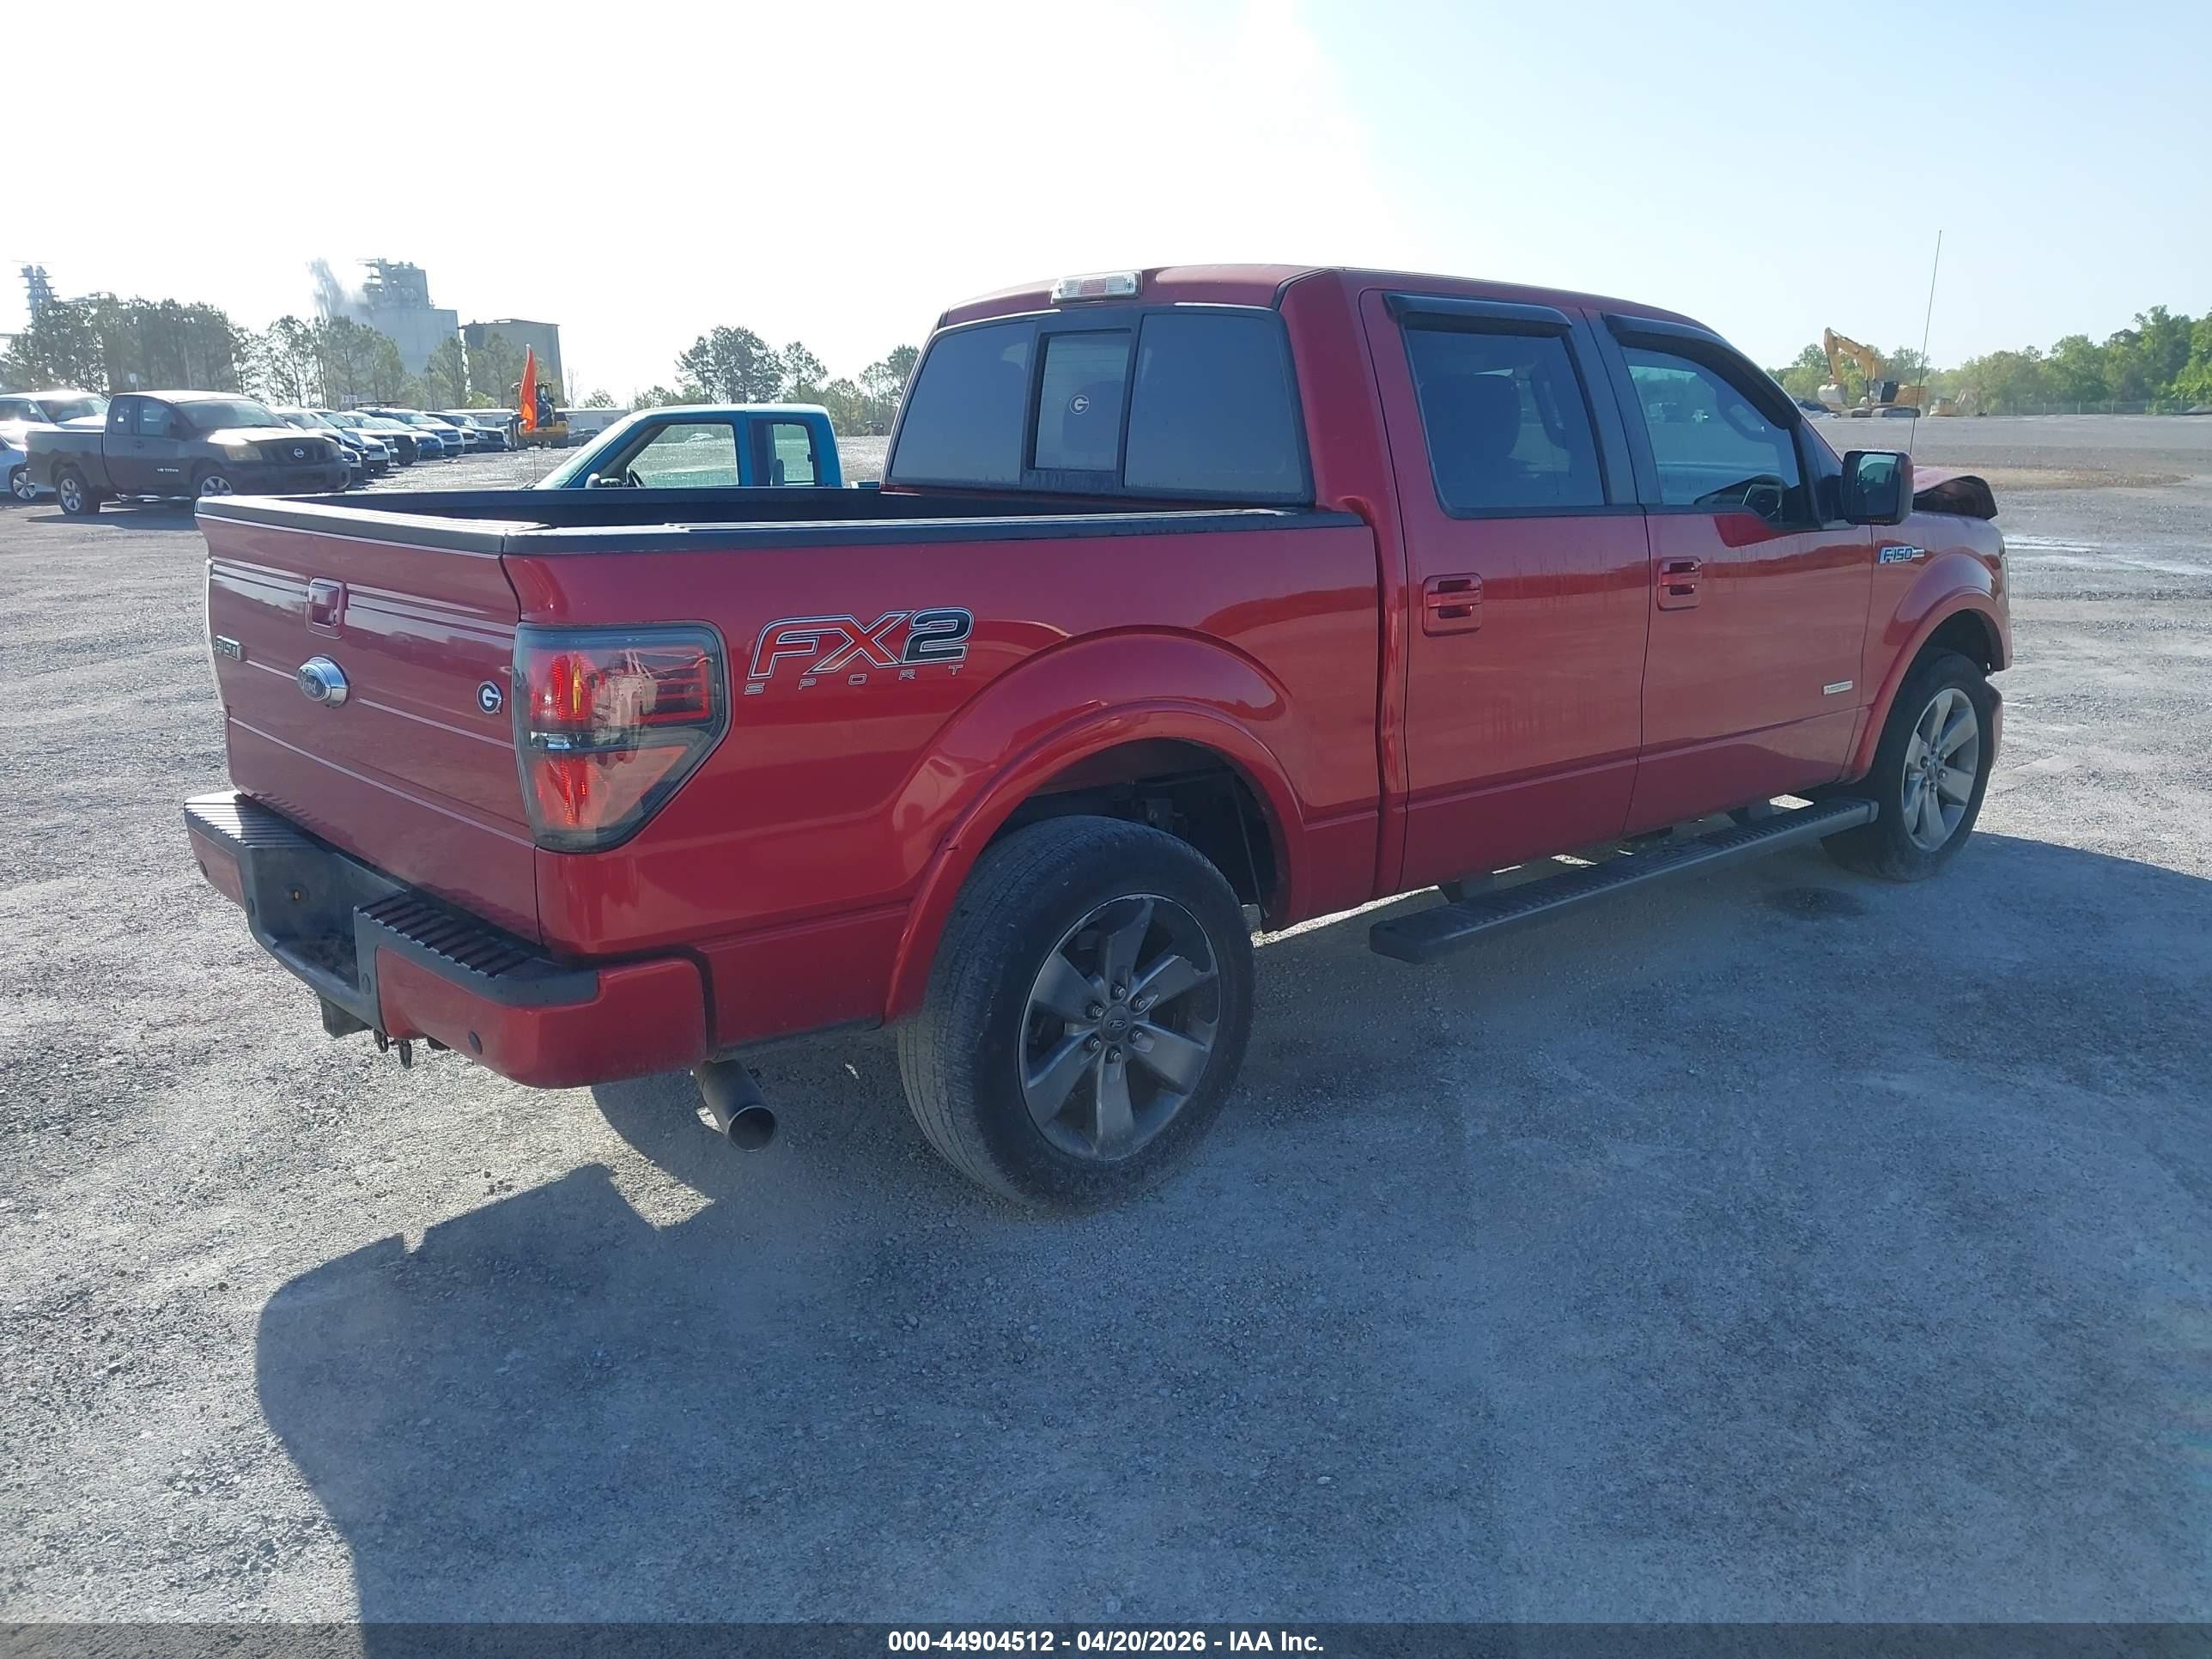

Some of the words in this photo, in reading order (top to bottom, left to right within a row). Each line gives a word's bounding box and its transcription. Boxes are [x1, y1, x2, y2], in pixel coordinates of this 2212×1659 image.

[1882, 548, 1913, 562] F-150
[747, 606, 975, 680] FX2
[744, 665, 963, 695] SPORT
[478, 684, 499, 711] G
